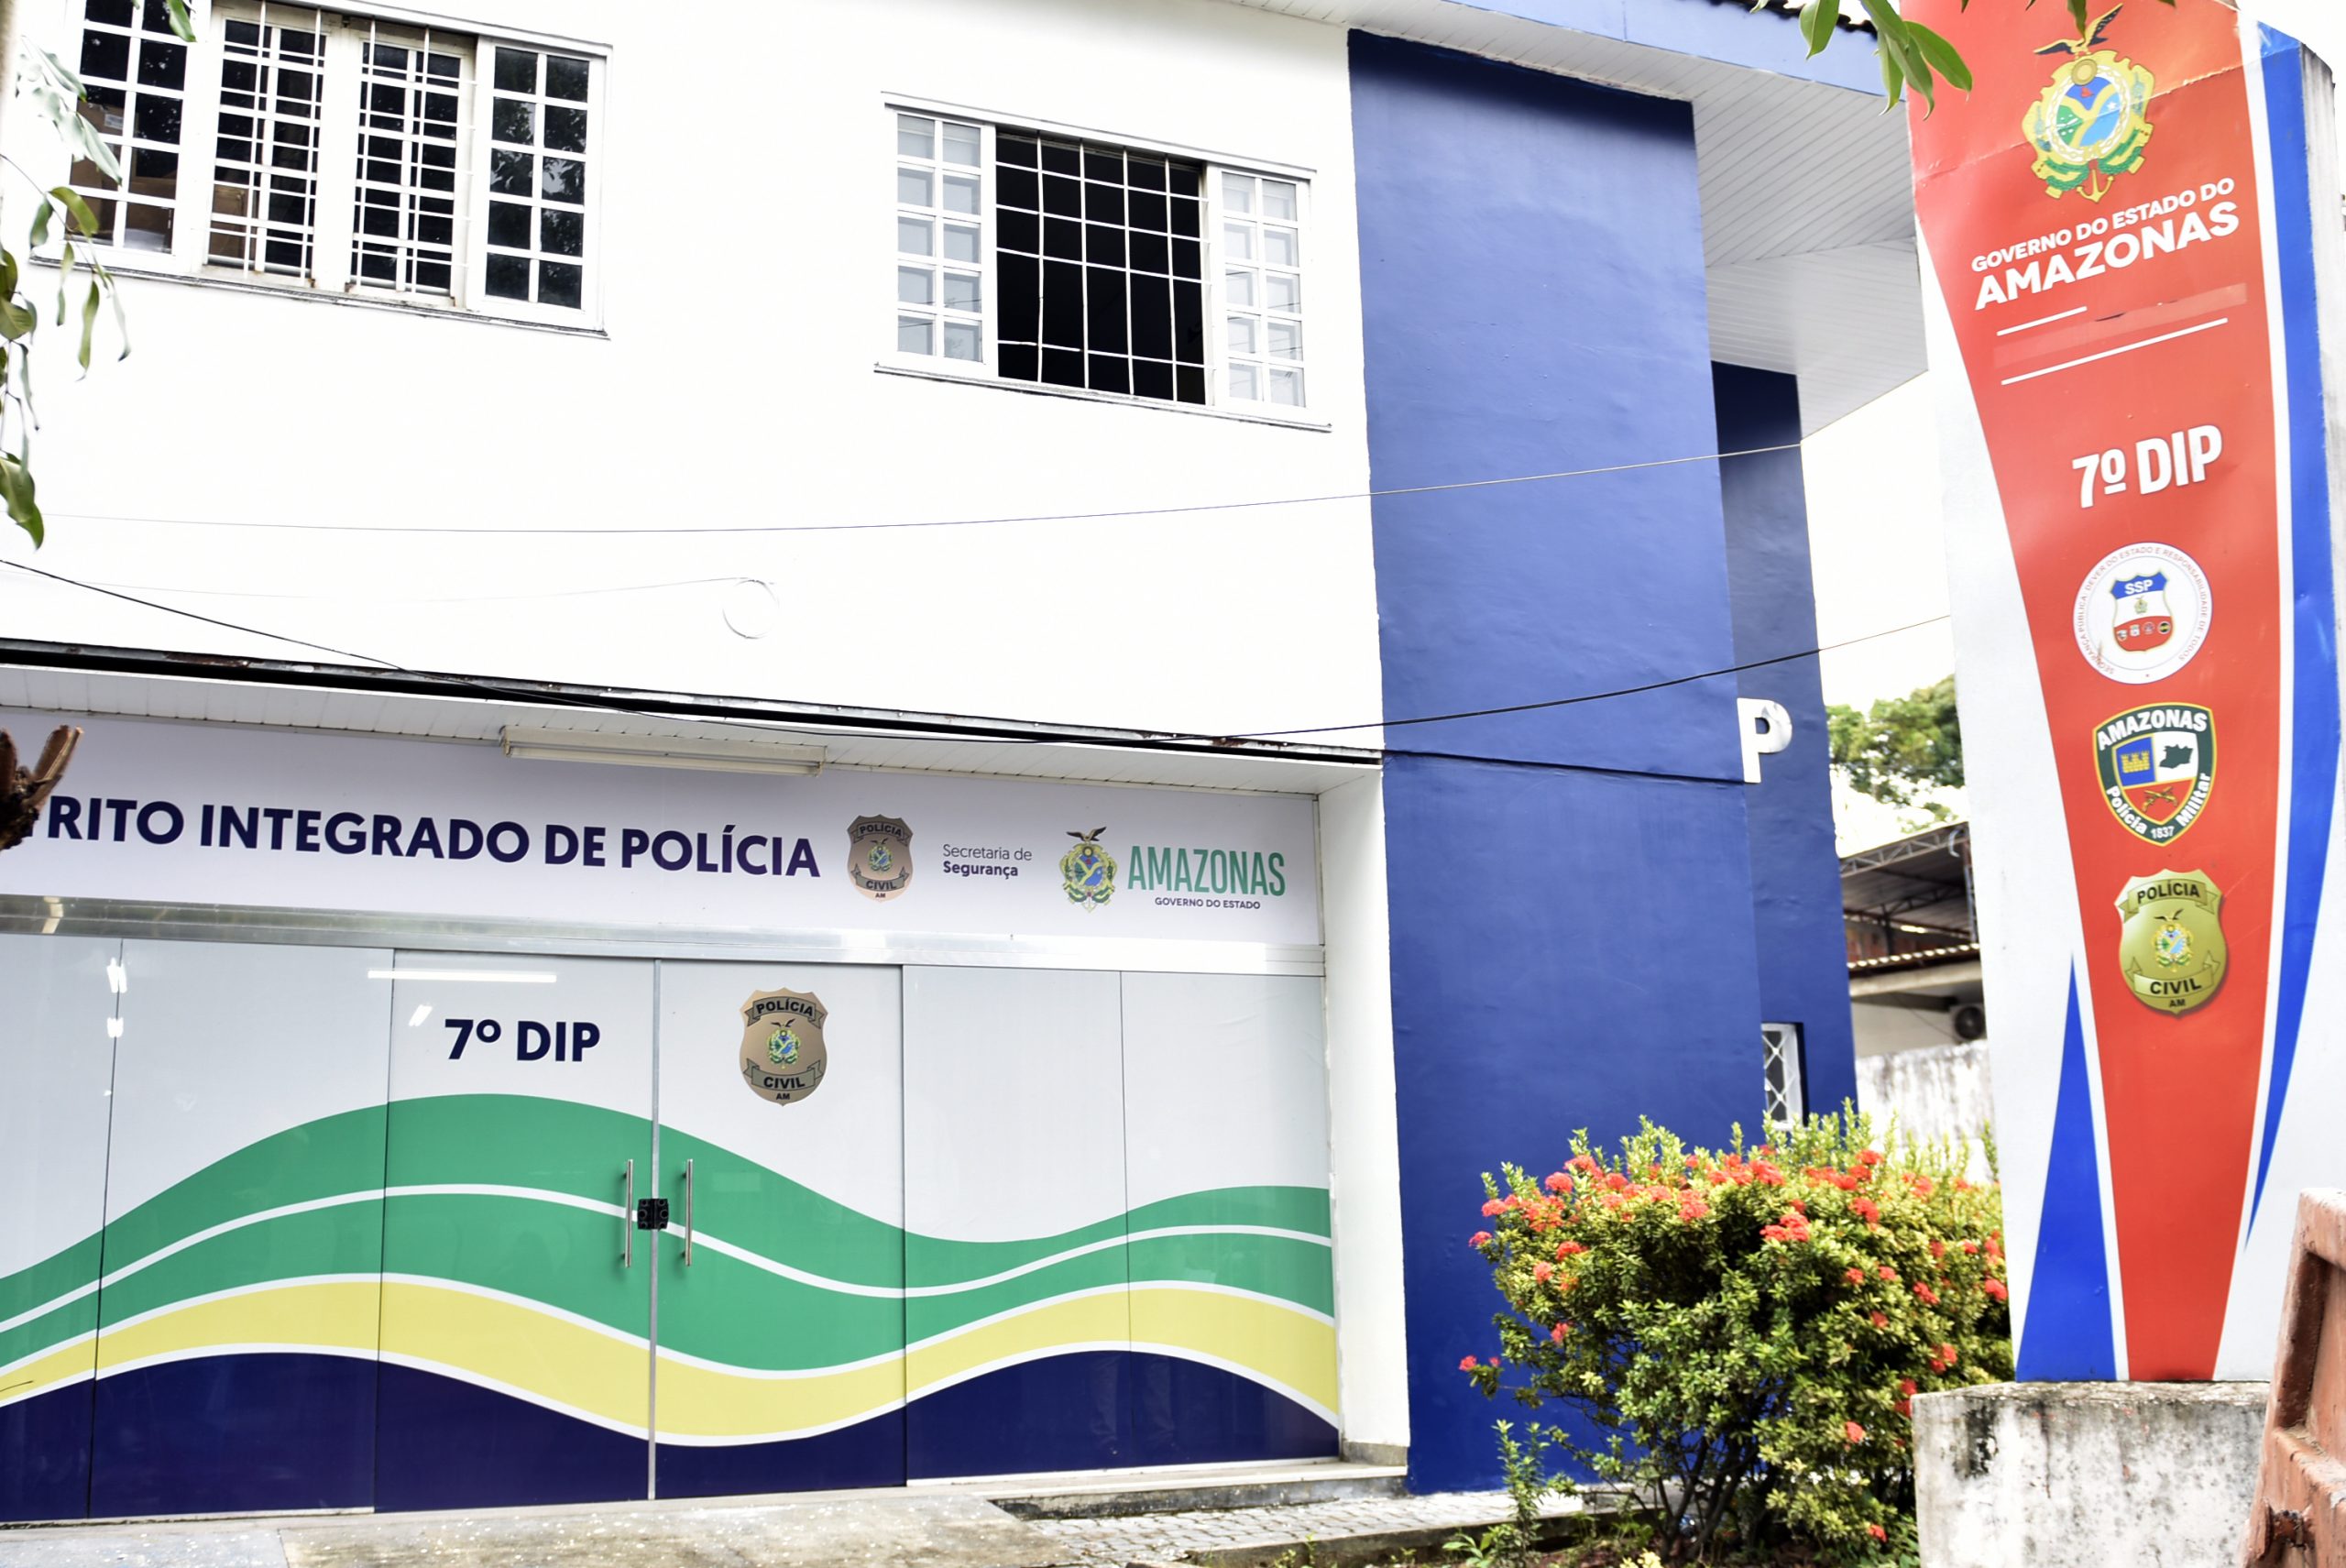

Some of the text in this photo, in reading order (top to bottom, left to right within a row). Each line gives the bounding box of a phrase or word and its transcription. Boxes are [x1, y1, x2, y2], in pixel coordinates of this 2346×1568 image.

[1971, 177, 2235, 272] GOVERNO DO ESTADO DO
[1975, 201, 2240, 311] AMAZONAS
[2071, 423, 2223, 509] 7º DIP
[2124, 579, 2154, 595] SSP
[2097, 709, 2208, 751] AMAZONAS
[1737, 697, 1792, 784] P
[2175, 773, 2211, 827] Militar
[2106, 785, 2149, 835] Polícia
[25, 795, 821, 878] RITO INTEGRADO DE POLÍCIA
[859, 823, 902, 837] POLÍCIA
[2151, 826, 2176, 839] 1837
[943, 843, 1033, 861] Secretaria de
[943, 861, 1018, 880] Segurança
[1127, 846, 1286, 896] AMAZONAS
[865, 880, 897, 890] CIVIL
[2136, 881, 2200, 905] POLÍCIA
[1155, 897, 1261, 910] GOVERNO DO ESTADO
[2150, 978, 2202, 995] CIVIL
[756, 998, 813, 1016] POLÍCIA
[2169, 998, 2187, 1008] AM
[516, 1020, 601, 1062] DIP
[763, 1076, 806, 1089] CIVIL
[776, 1092, 790, 1101] AM
